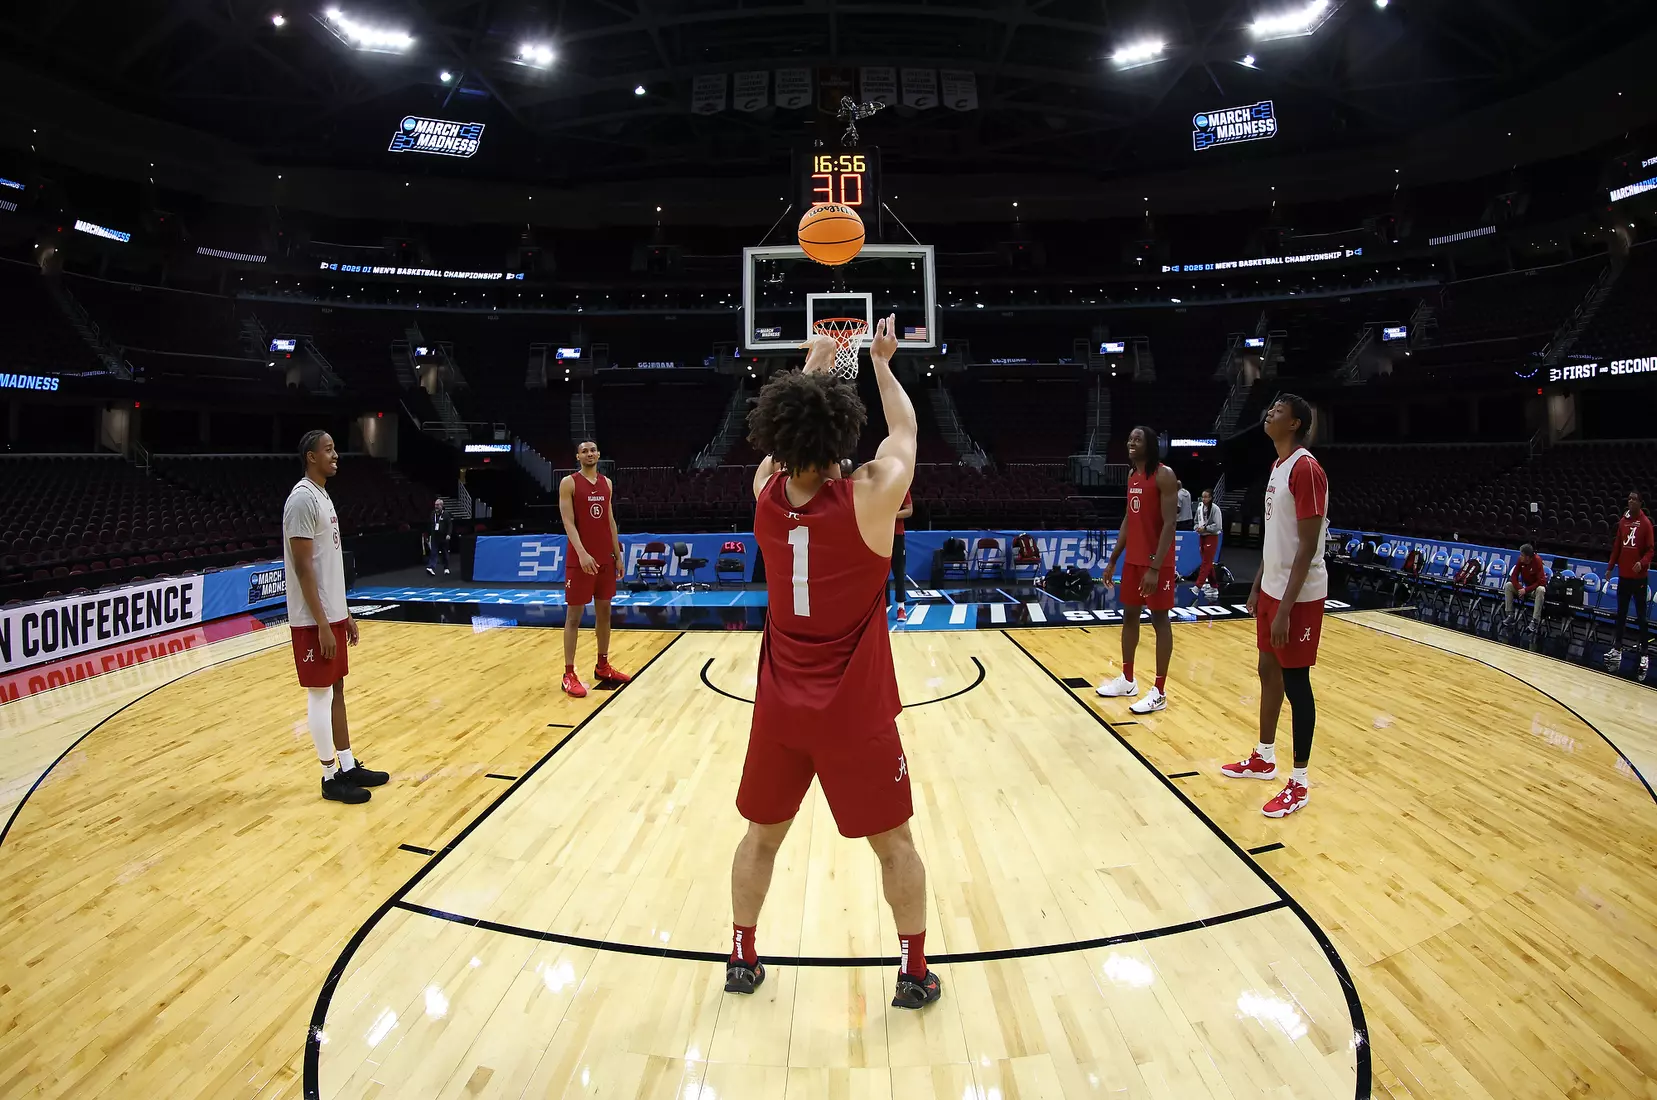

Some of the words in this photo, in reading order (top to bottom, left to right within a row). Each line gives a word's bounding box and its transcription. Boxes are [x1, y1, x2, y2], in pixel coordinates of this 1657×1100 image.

[1208, 108, 1251, 127] MARCH
[414, 120, 460, 137] MARCH
[1216, 118, 1275, 139] MADNESS
[416, 133, 478, 152] MADNESS
[814, 155, 866, 173] 16:56
[811, 174, 862, 206] 30
[1184, 264, 1204, 272] 2025
[1215, 261, 1238, 270] MEN'S
[1238, 257, 1284, 268] BASKETBALL
[1285, 251, 1342, 264] CHAMPIONSHIP
[341, 264, 361, 273] 2025
[373, 266, 395, 275] MEN'S
[397, 268, 443, 278] BASKETBALL
[443, 270, 503, 280] CHAMPIONSHIP
[1563, 363, 1598, 380] FIRST
[1611, 356, 1657, 375] SECOND
[0, 373, 60, 391] MADNESS
[258, 570, 282, 585] MARCH
[787, 525, 811, 617] 1
[22, 583, 194, 657] CONFERENCE
